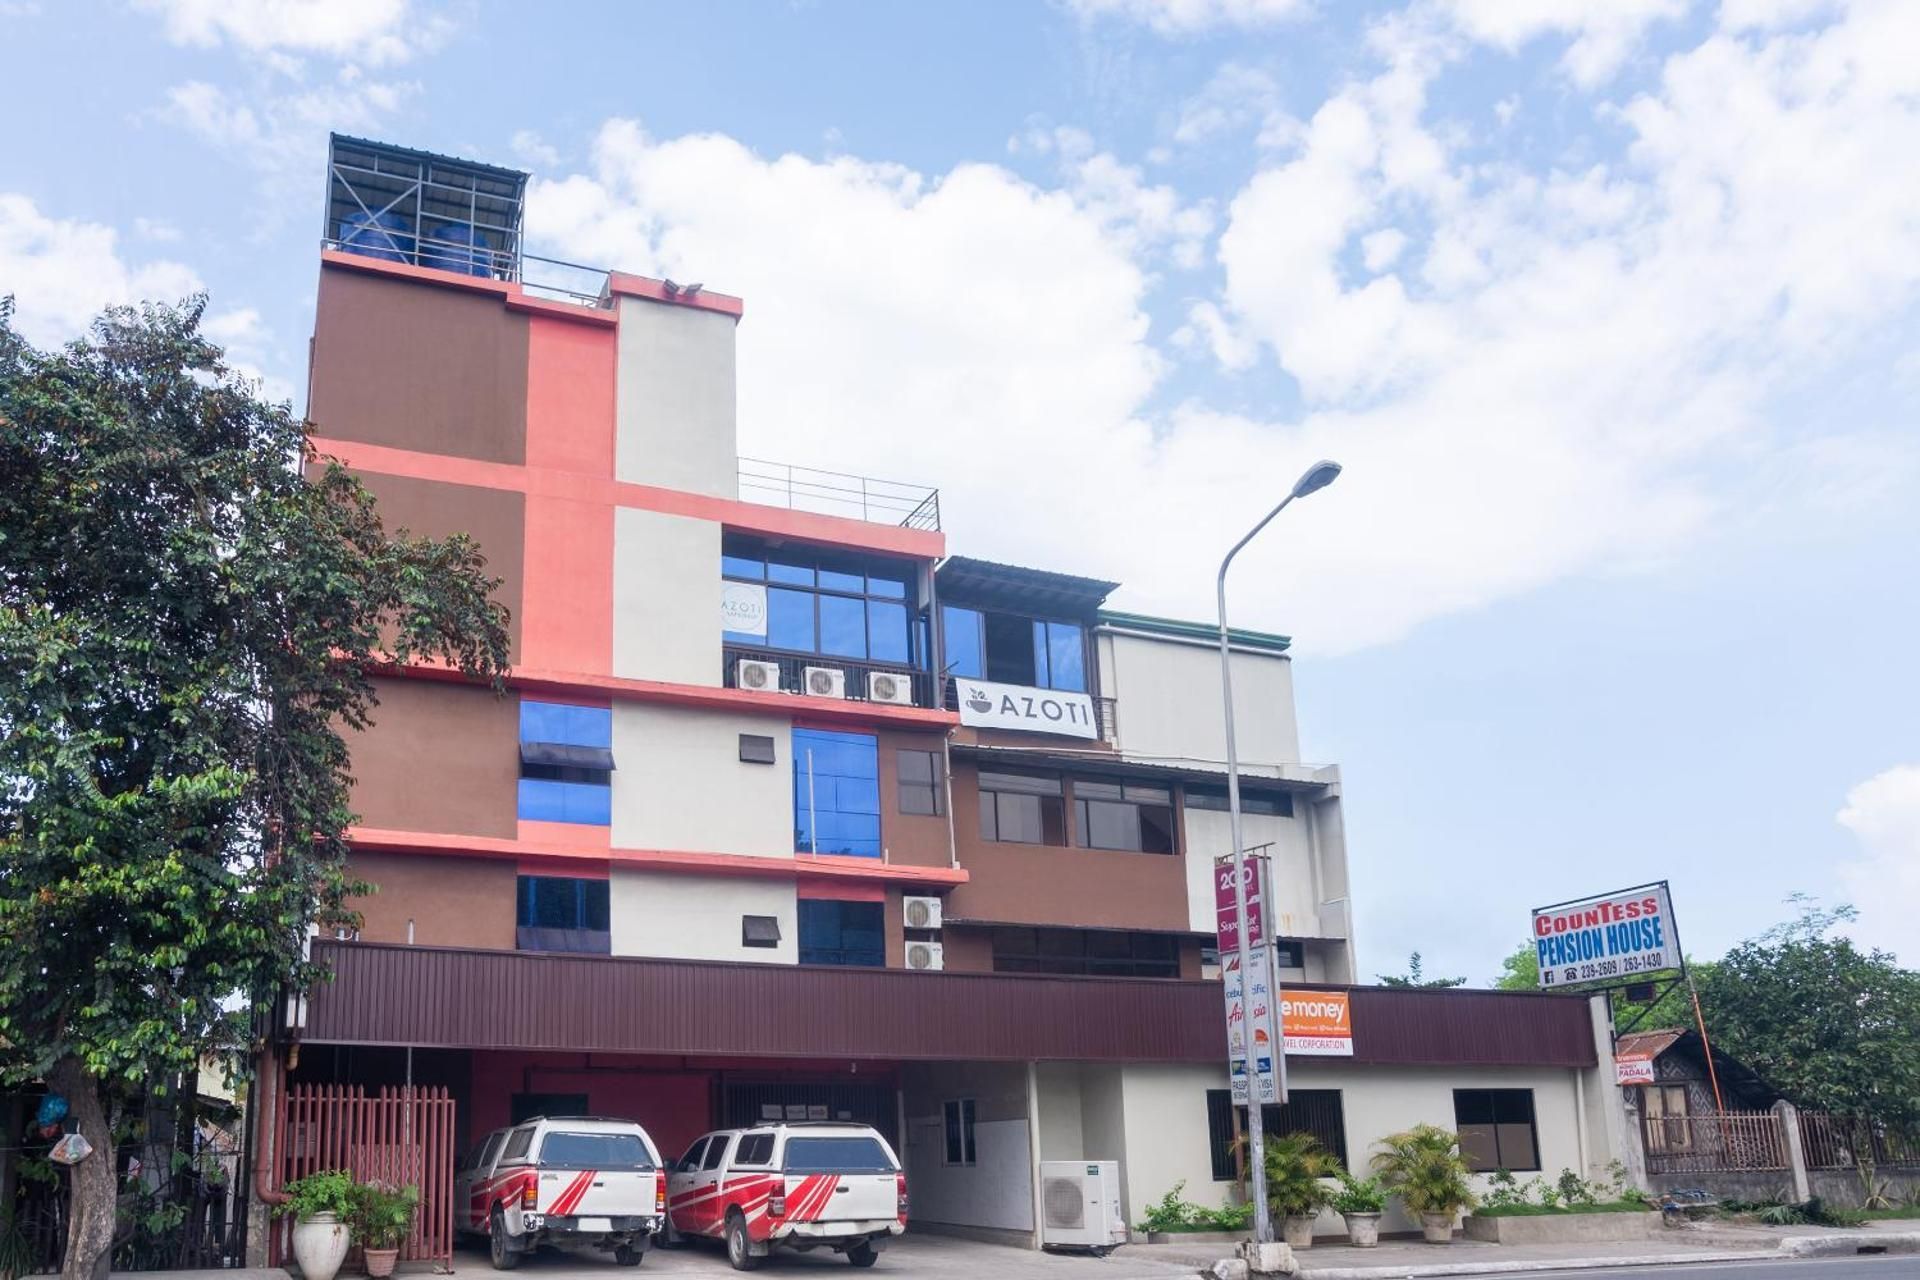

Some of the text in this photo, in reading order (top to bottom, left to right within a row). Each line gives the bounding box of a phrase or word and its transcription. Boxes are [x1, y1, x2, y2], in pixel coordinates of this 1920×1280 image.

[721, 593, 761, 614] AZOTI
[1000, 694, 1089, 726] AZOTI
[1537, 916, 1664, 968] PENSION HOUSE
[1623, 952, 1662, 973] 263-1430
[1298, 1038, 1345, 1050] CORPORATION
[1619, 1068, 1651, 1077] PADALA
